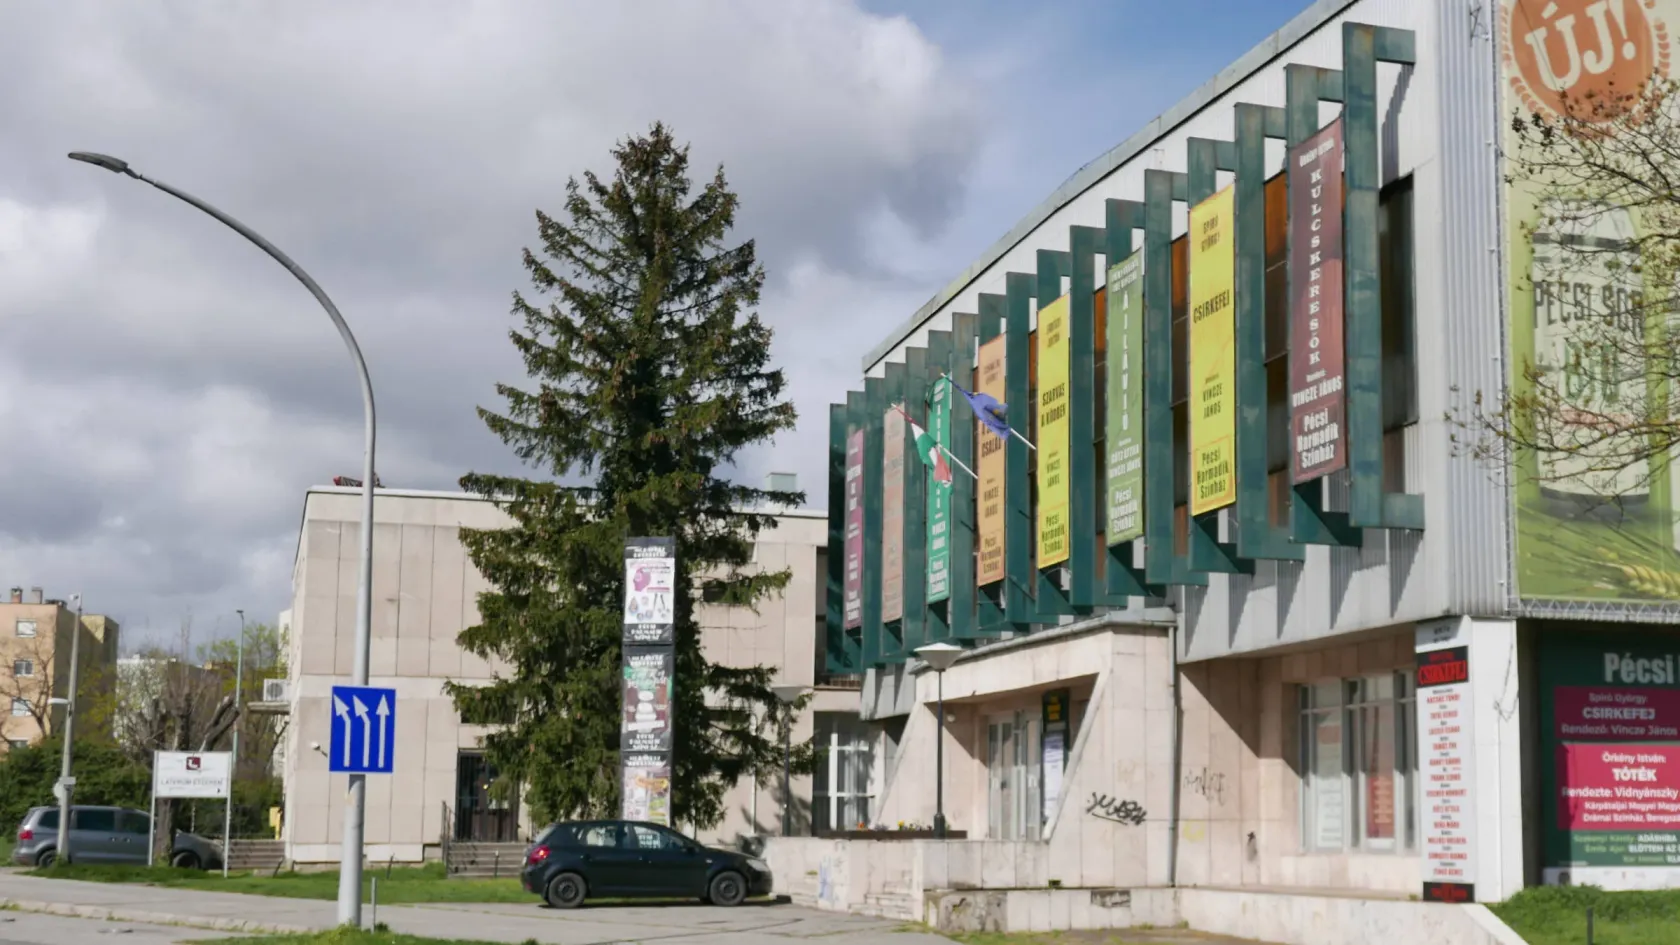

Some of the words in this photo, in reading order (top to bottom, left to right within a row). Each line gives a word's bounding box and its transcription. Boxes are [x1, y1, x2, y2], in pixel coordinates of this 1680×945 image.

[1524, 0, 1637, 91] ÚJ!
[1193, 289, 1230, 324] CSIRKEFEJ
[1304, 408, 1328, 432] Pécsi
[1604, 652, 1674, 684] Pécsi
[1582, 707, 1656, 720] CSIRKEFEJ
[1611, 724, 1646, 736] Vincze
[1648, 724, 1678, 736] János
[1602, 750, 1635, 764] Örkény
[1612, 766, 1657, 782] TÓTÉK
[1562, 787, 1613, 798] Rendezte:
[1615, 787, 1678, 800] Vidnyánszky
